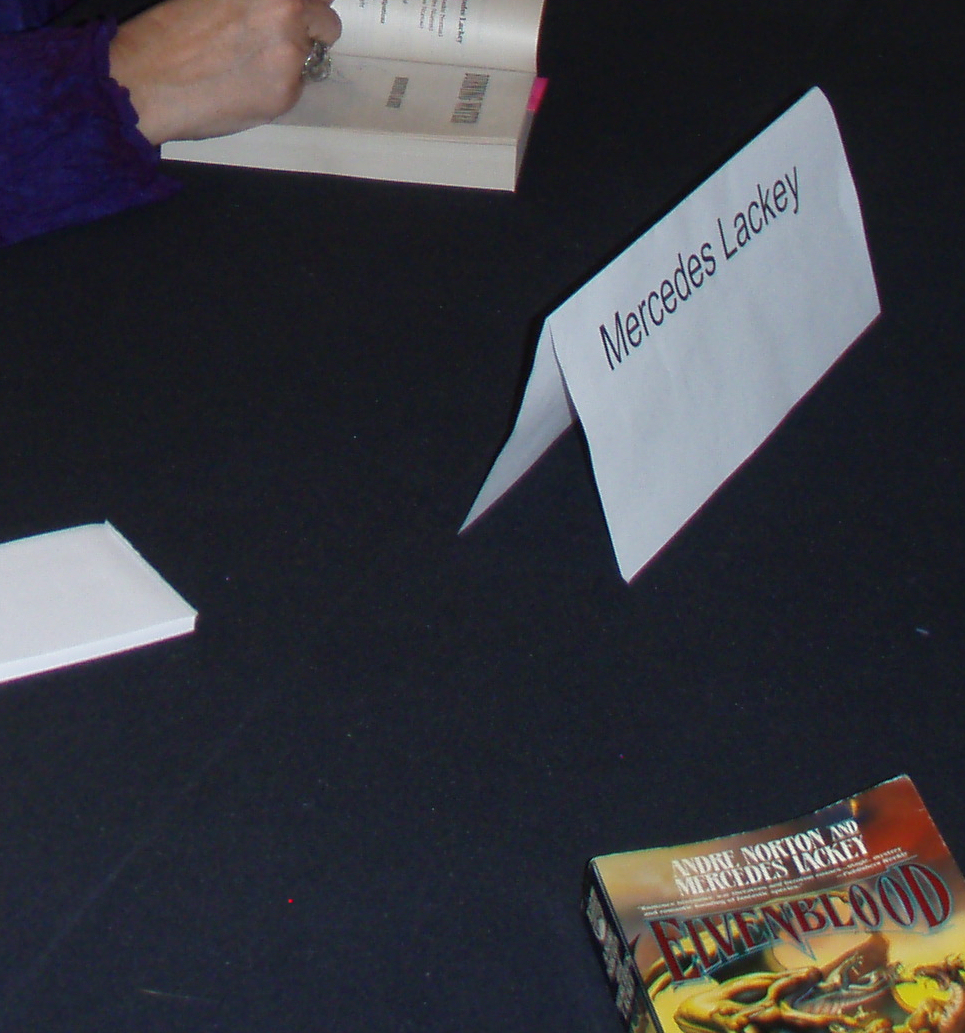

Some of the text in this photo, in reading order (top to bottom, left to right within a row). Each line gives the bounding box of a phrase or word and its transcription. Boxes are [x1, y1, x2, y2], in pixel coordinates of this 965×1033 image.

[598, 166, 800, 371] Mercedes Lackey
[671, 849, 740, 878] ANDRE
[740, 828, 826, 866] NORTON
[830, 819, 859, 842] AND
[673, 859, 789, 897] MERCEDES
[792, 834, 869, 876] LACKEY
[644, 862, 954, 985] ELVENBLOOD
